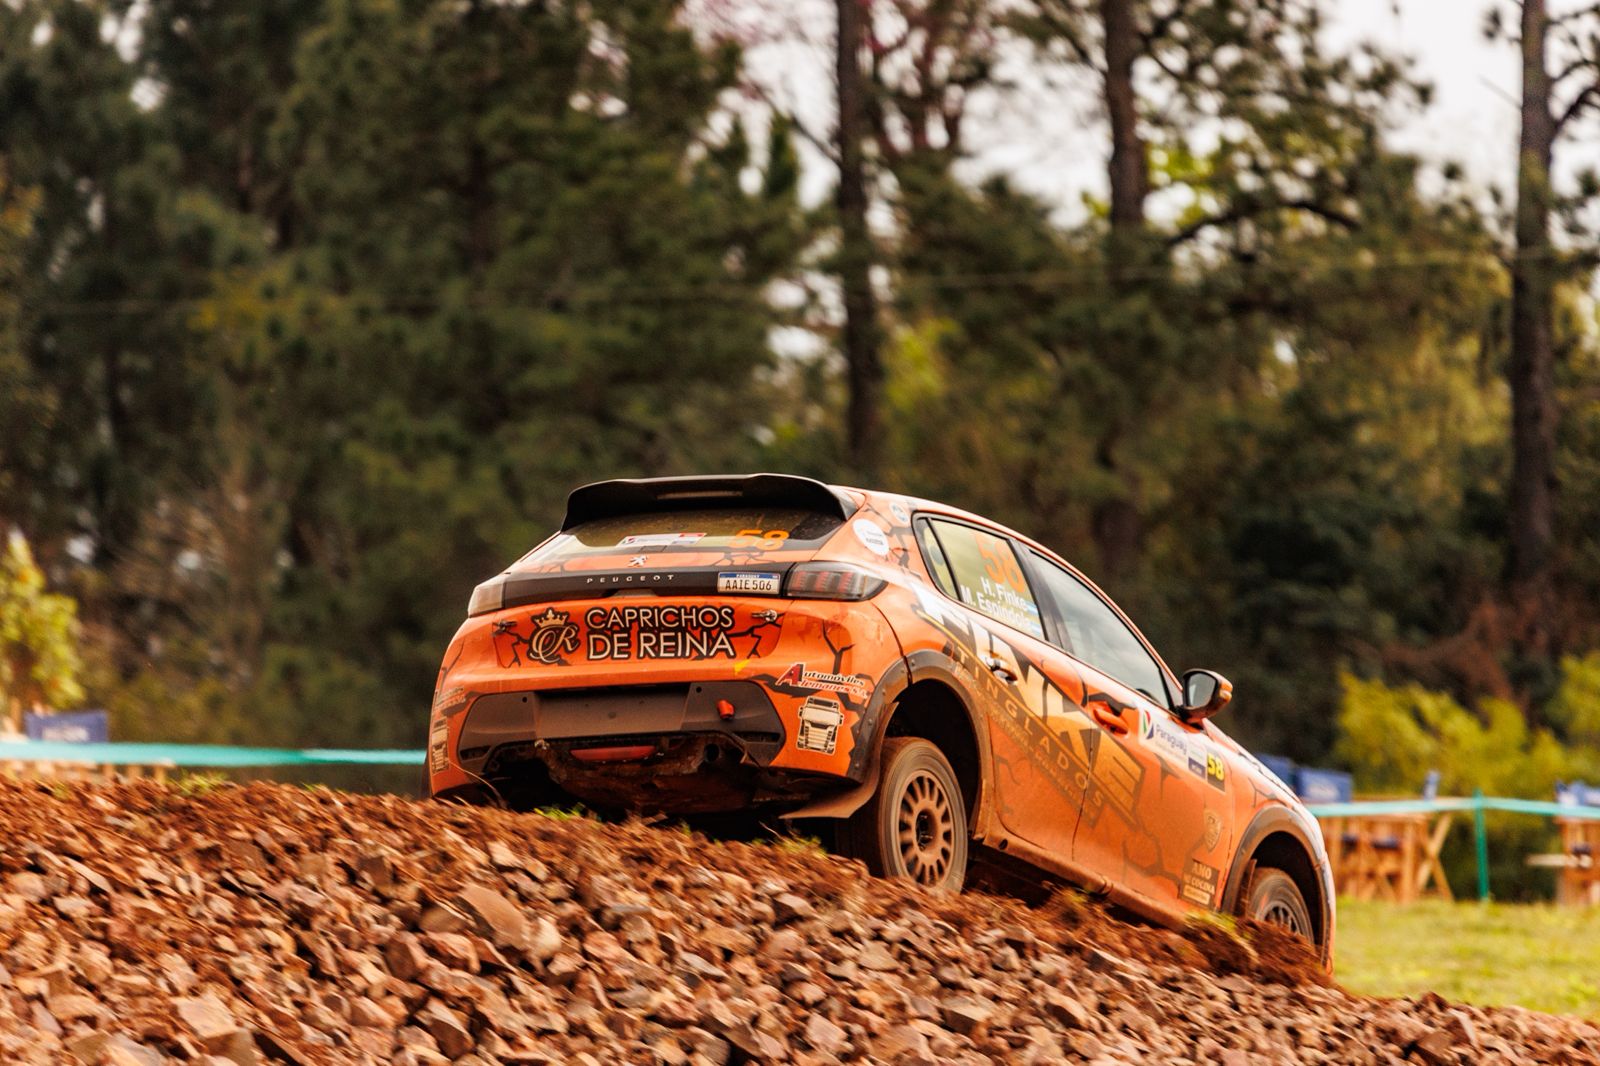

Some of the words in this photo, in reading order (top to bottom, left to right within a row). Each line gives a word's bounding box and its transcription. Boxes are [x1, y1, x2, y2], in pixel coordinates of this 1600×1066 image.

[975, 531, 1026, 593] 58
[586, 574, 675, 584] PEUGEOT
[725, 579, 750, 590] AAIE
[752, 579, 772, 591] 506
[995, 583, 1029, 612] Finke
[586, 607, 734, 629] CAPRICHOS
[588, 633, 629, 660] DE
[639, 631, 735, 659] REINA
[951, 646, 1104, 807] TINGLADOS
[1155, 723, 1188, 756] Paraguay
[1206, 752, 1226, 781] 58
